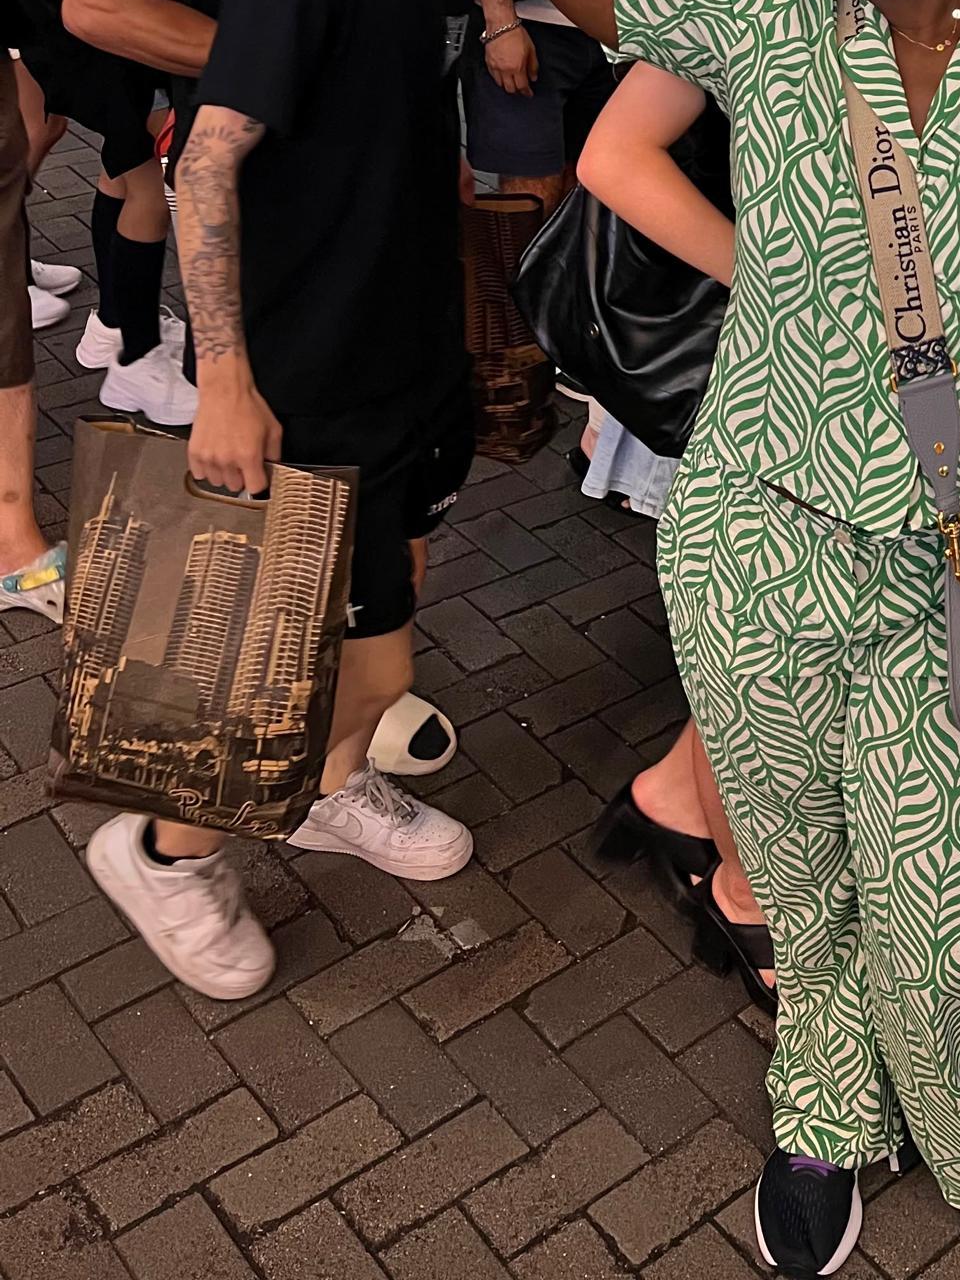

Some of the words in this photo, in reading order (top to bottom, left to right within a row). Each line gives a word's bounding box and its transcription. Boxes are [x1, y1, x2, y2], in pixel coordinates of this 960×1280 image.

[867, 125, 903, 200] Dior
[906, 205, 924, 254] PARIS
[888, 204, 927, 344] Christian
